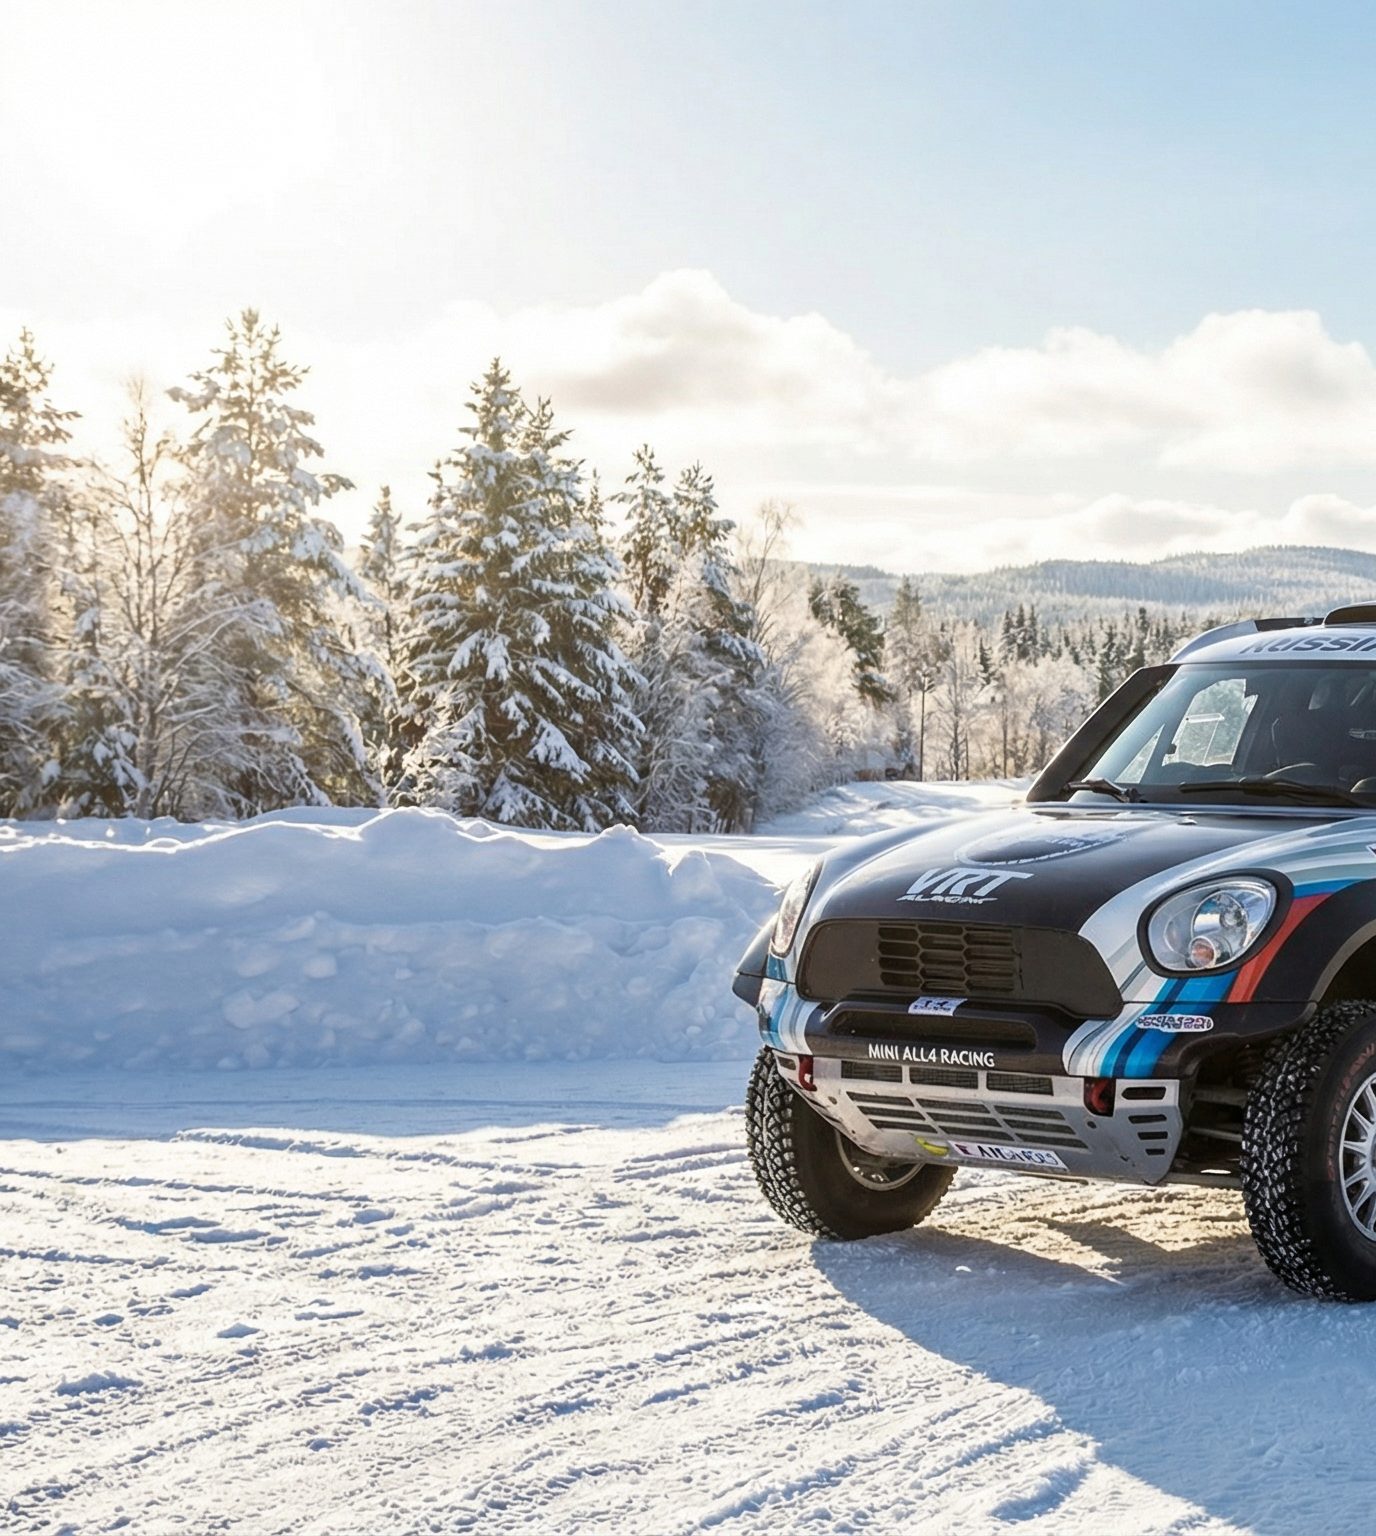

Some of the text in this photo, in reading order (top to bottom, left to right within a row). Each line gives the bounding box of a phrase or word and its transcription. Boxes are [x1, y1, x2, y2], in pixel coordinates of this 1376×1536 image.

[906, 867, 1034, 897] VRT
[868, 1043, 995, 1068] MINI ALL4 RACING
